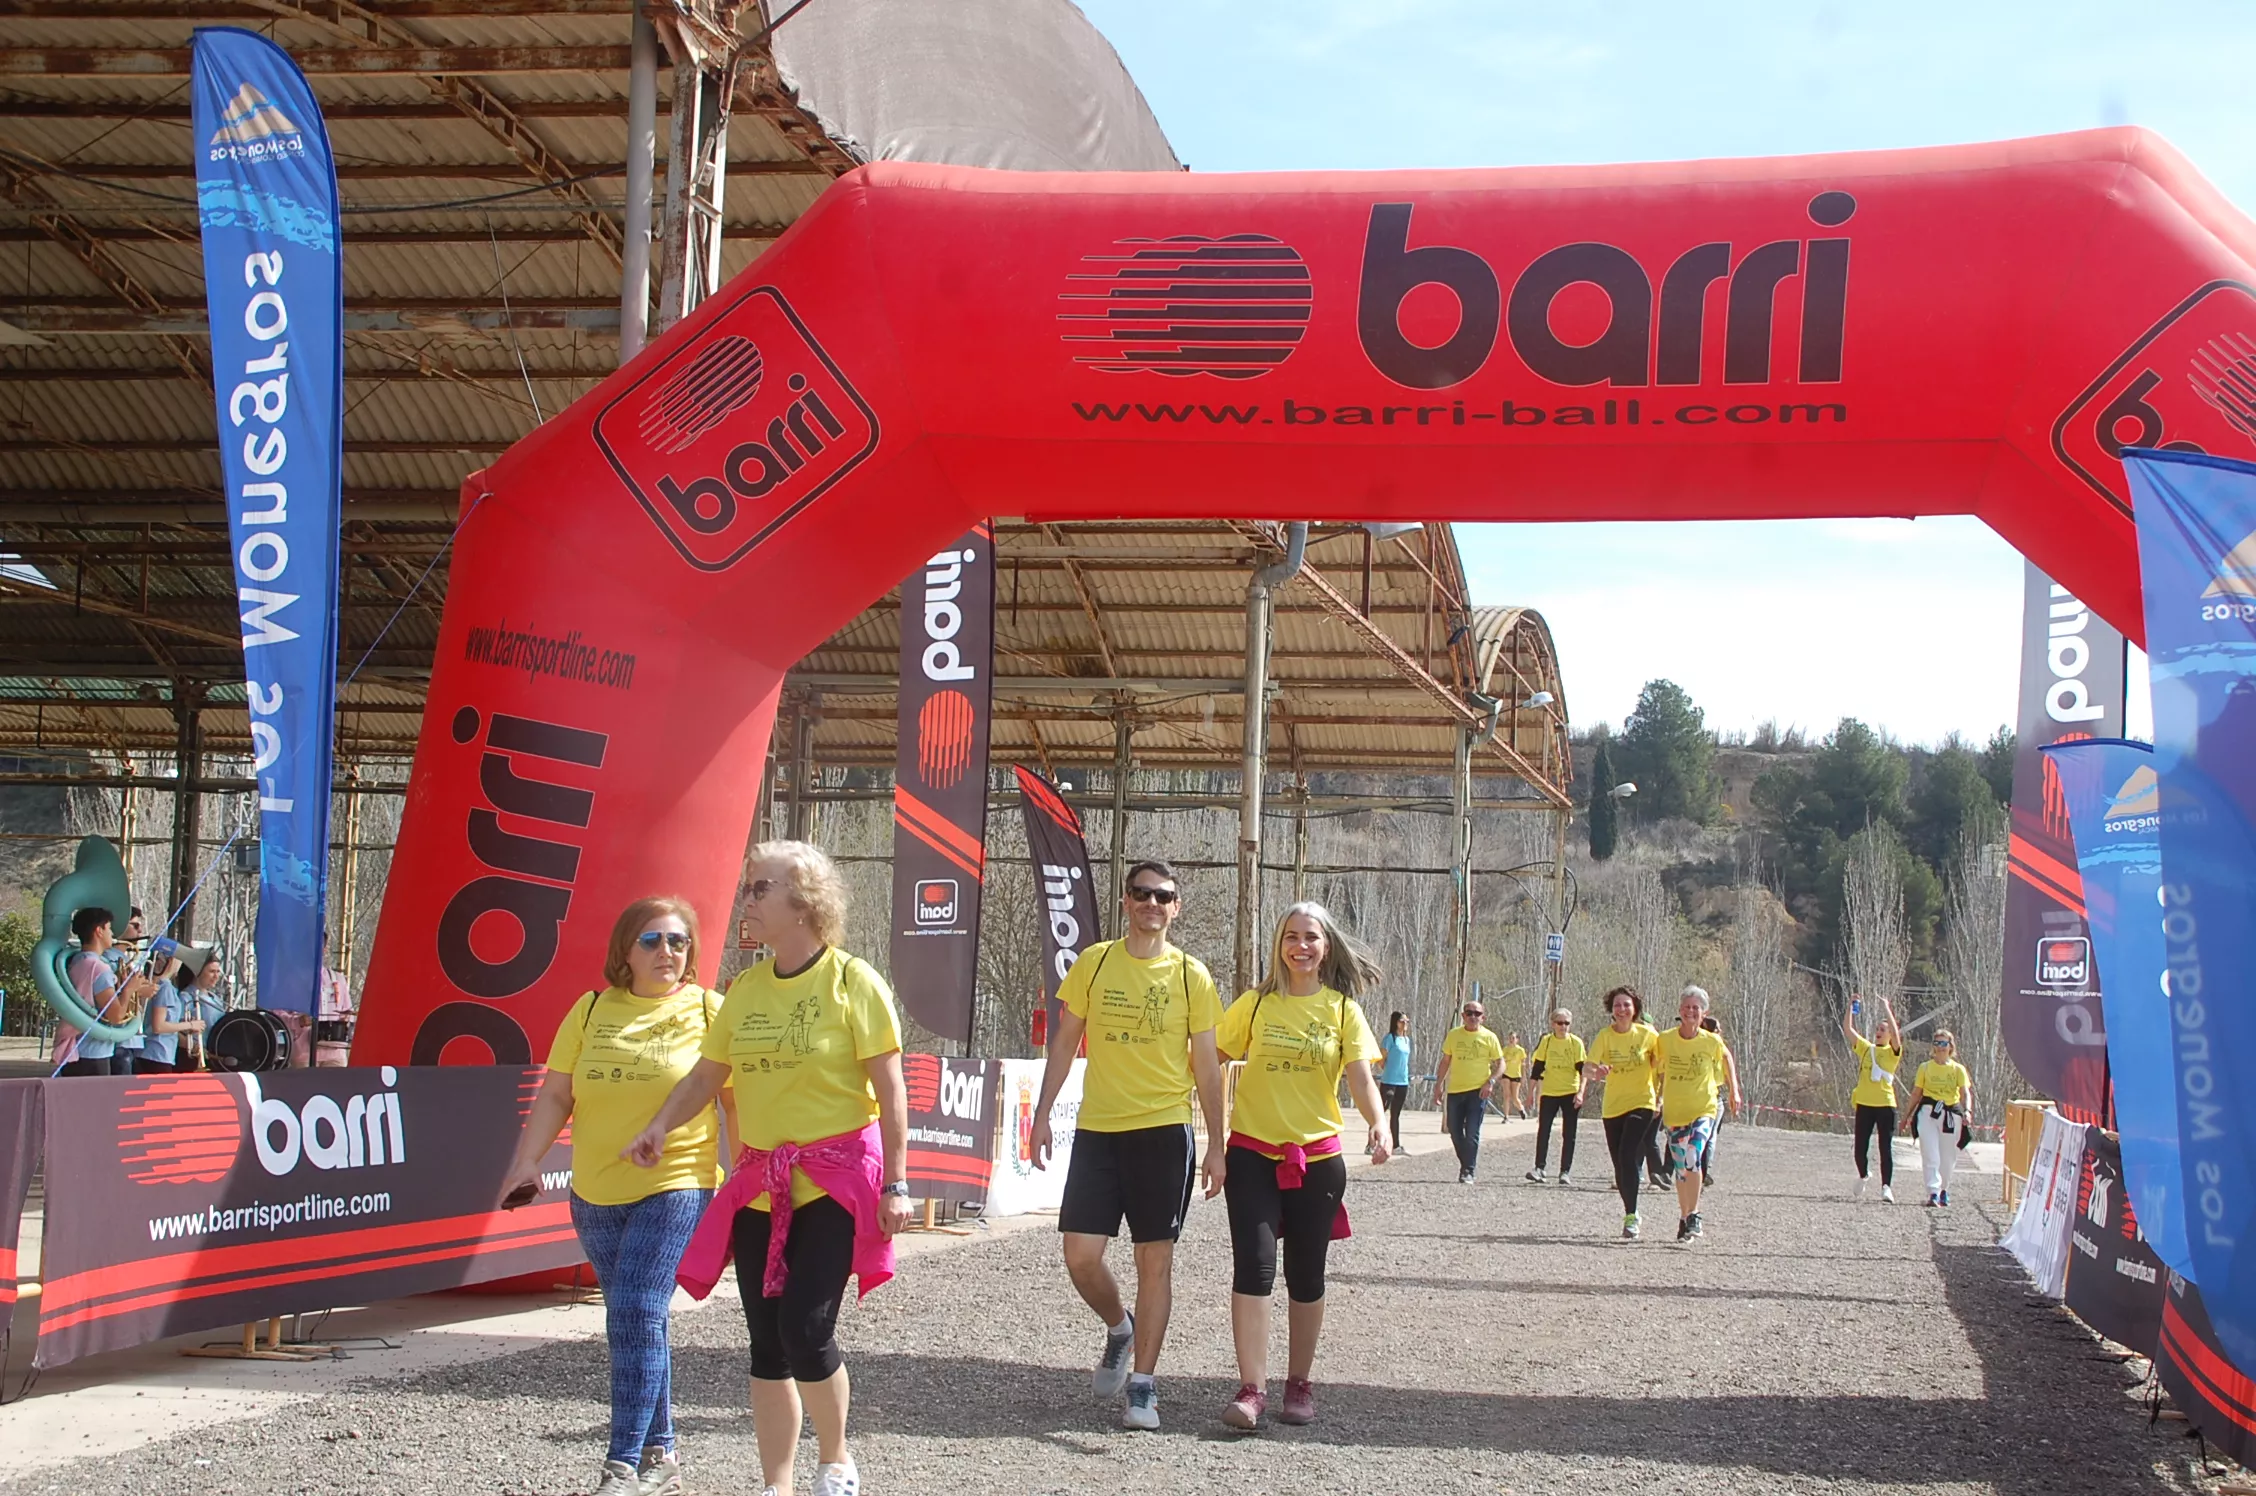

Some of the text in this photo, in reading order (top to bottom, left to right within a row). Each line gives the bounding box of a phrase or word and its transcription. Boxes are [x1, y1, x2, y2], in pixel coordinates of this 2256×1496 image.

[1357, 190, 1857, 390] barri
[1072, 399, 1848, 426] www.barri-ball.com
[656, 373, 846, 535] barri
[464, 618, 636, 690] www.barrisportline.com
[238, 1066, 405, 1176] barri
[940, 1057, 986, 1121] barri
[149, 1192, 391, 1241] www.barrisportline.com
